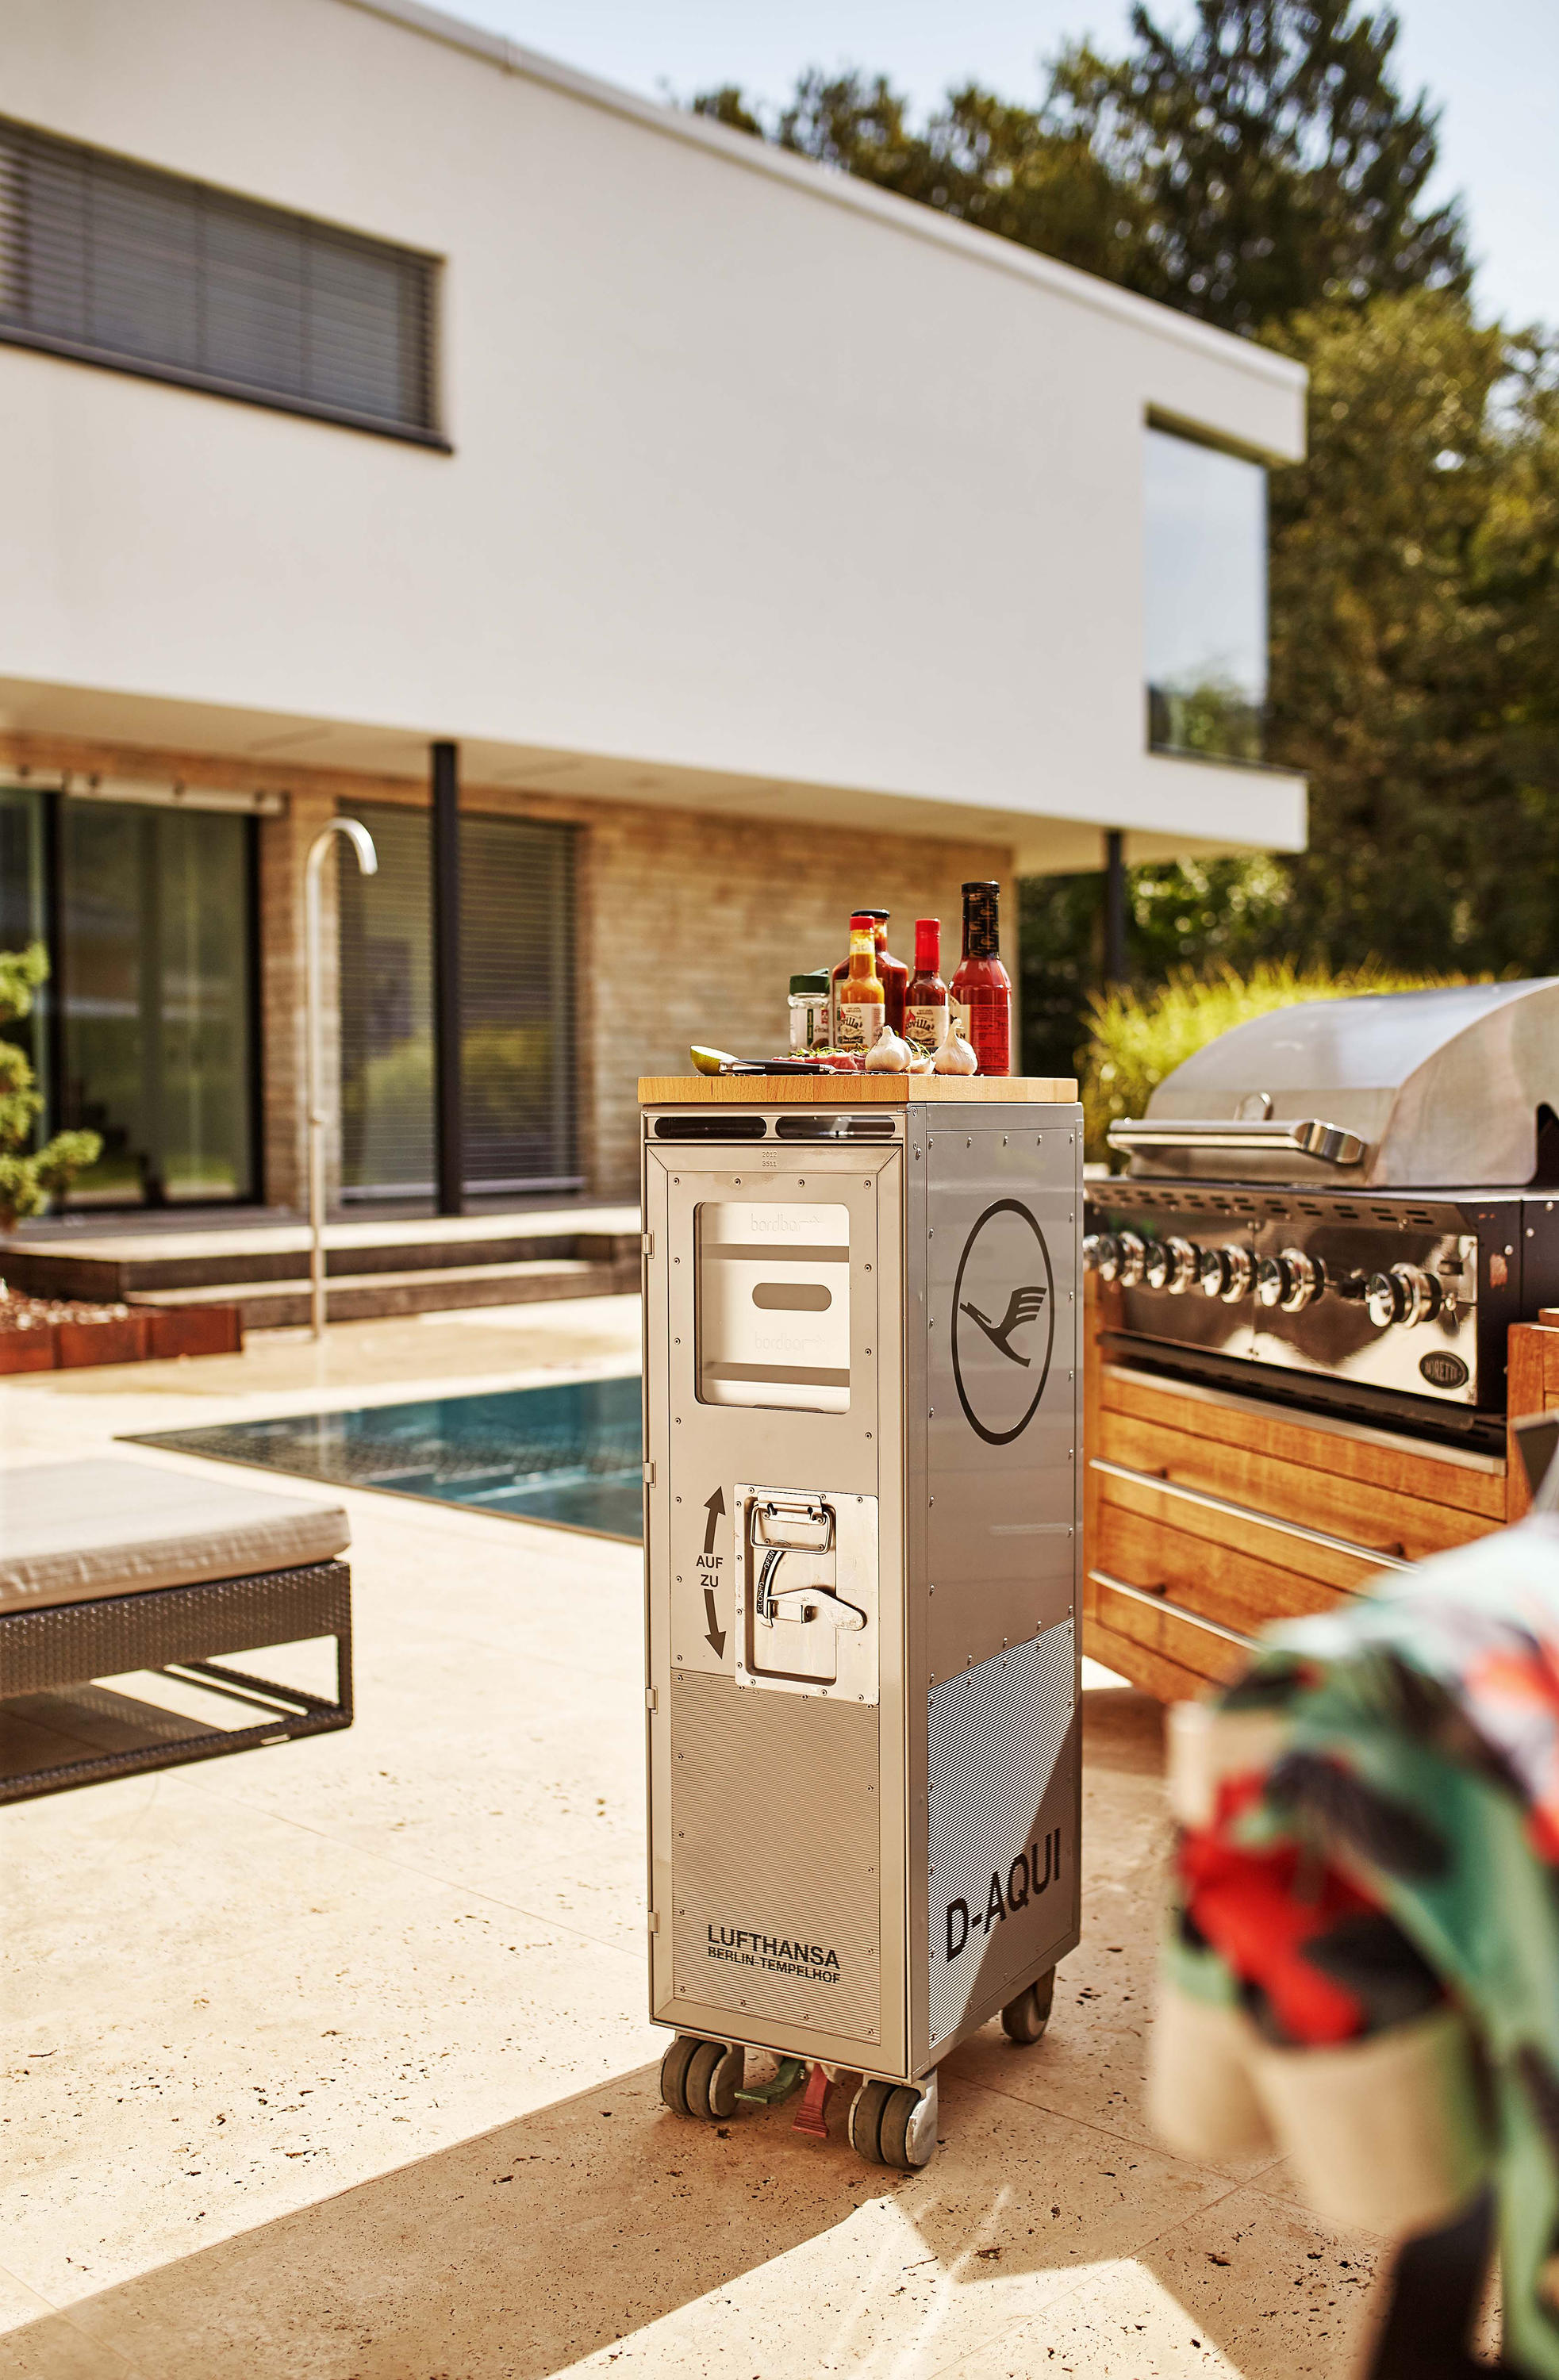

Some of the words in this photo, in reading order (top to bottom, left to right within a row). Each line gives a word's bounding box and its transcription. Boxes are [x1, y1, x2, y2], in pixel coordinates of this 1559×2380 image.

[696, 1555, 723, 1568] AUF
[764, 1550, 775, 1570] OPEN
[701, 1574, 719, 1587] ZU
[947, 1827, 1061, 1963] D-AQUI
[708, 1924, 840, 1970] LUFTHANSA
[708, 1946, 841, 1983] BERLIN-TEMPELHOF
